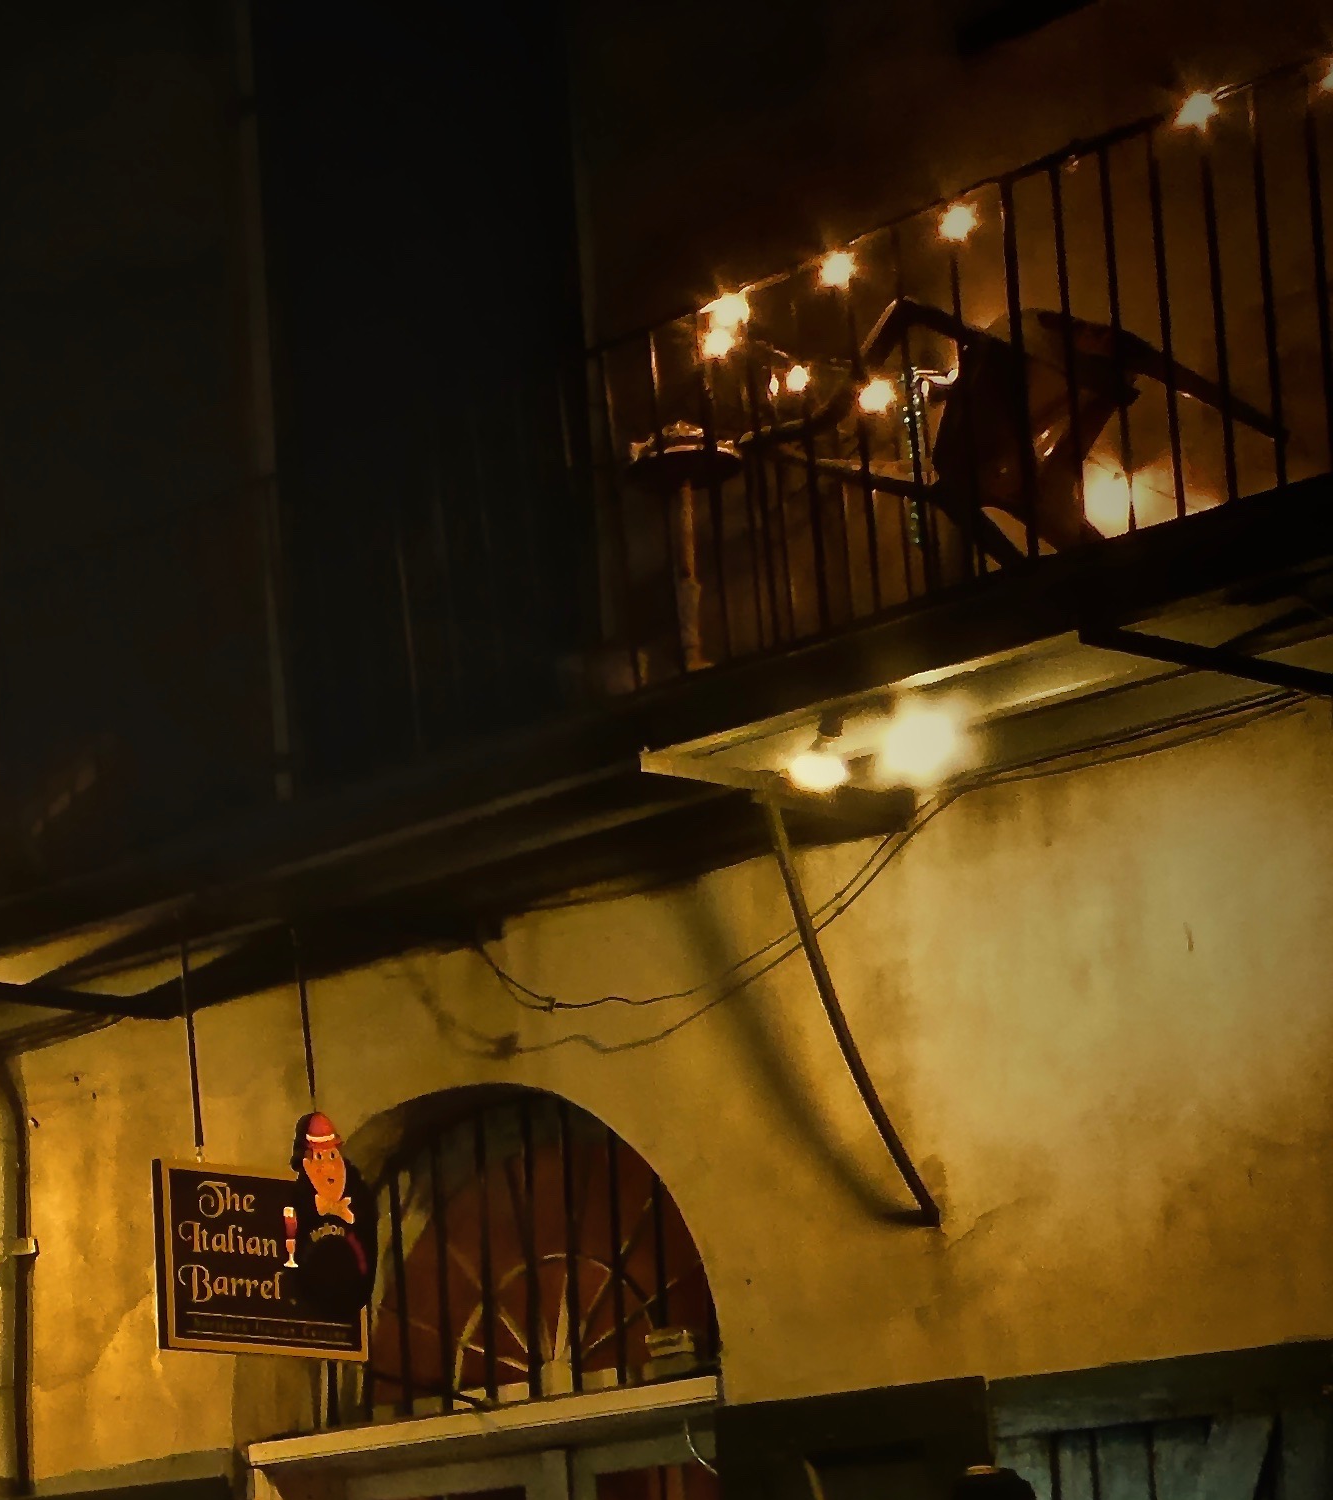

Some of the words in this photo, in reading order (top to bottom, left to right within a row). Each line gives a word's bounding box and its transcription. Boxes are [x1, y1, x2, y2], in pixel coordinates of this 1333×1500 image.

[196, 1180, 255, 1219] The
[178, 1220, 278, 1258] Italian
[178, 1264, 283, 1303] Barrel
